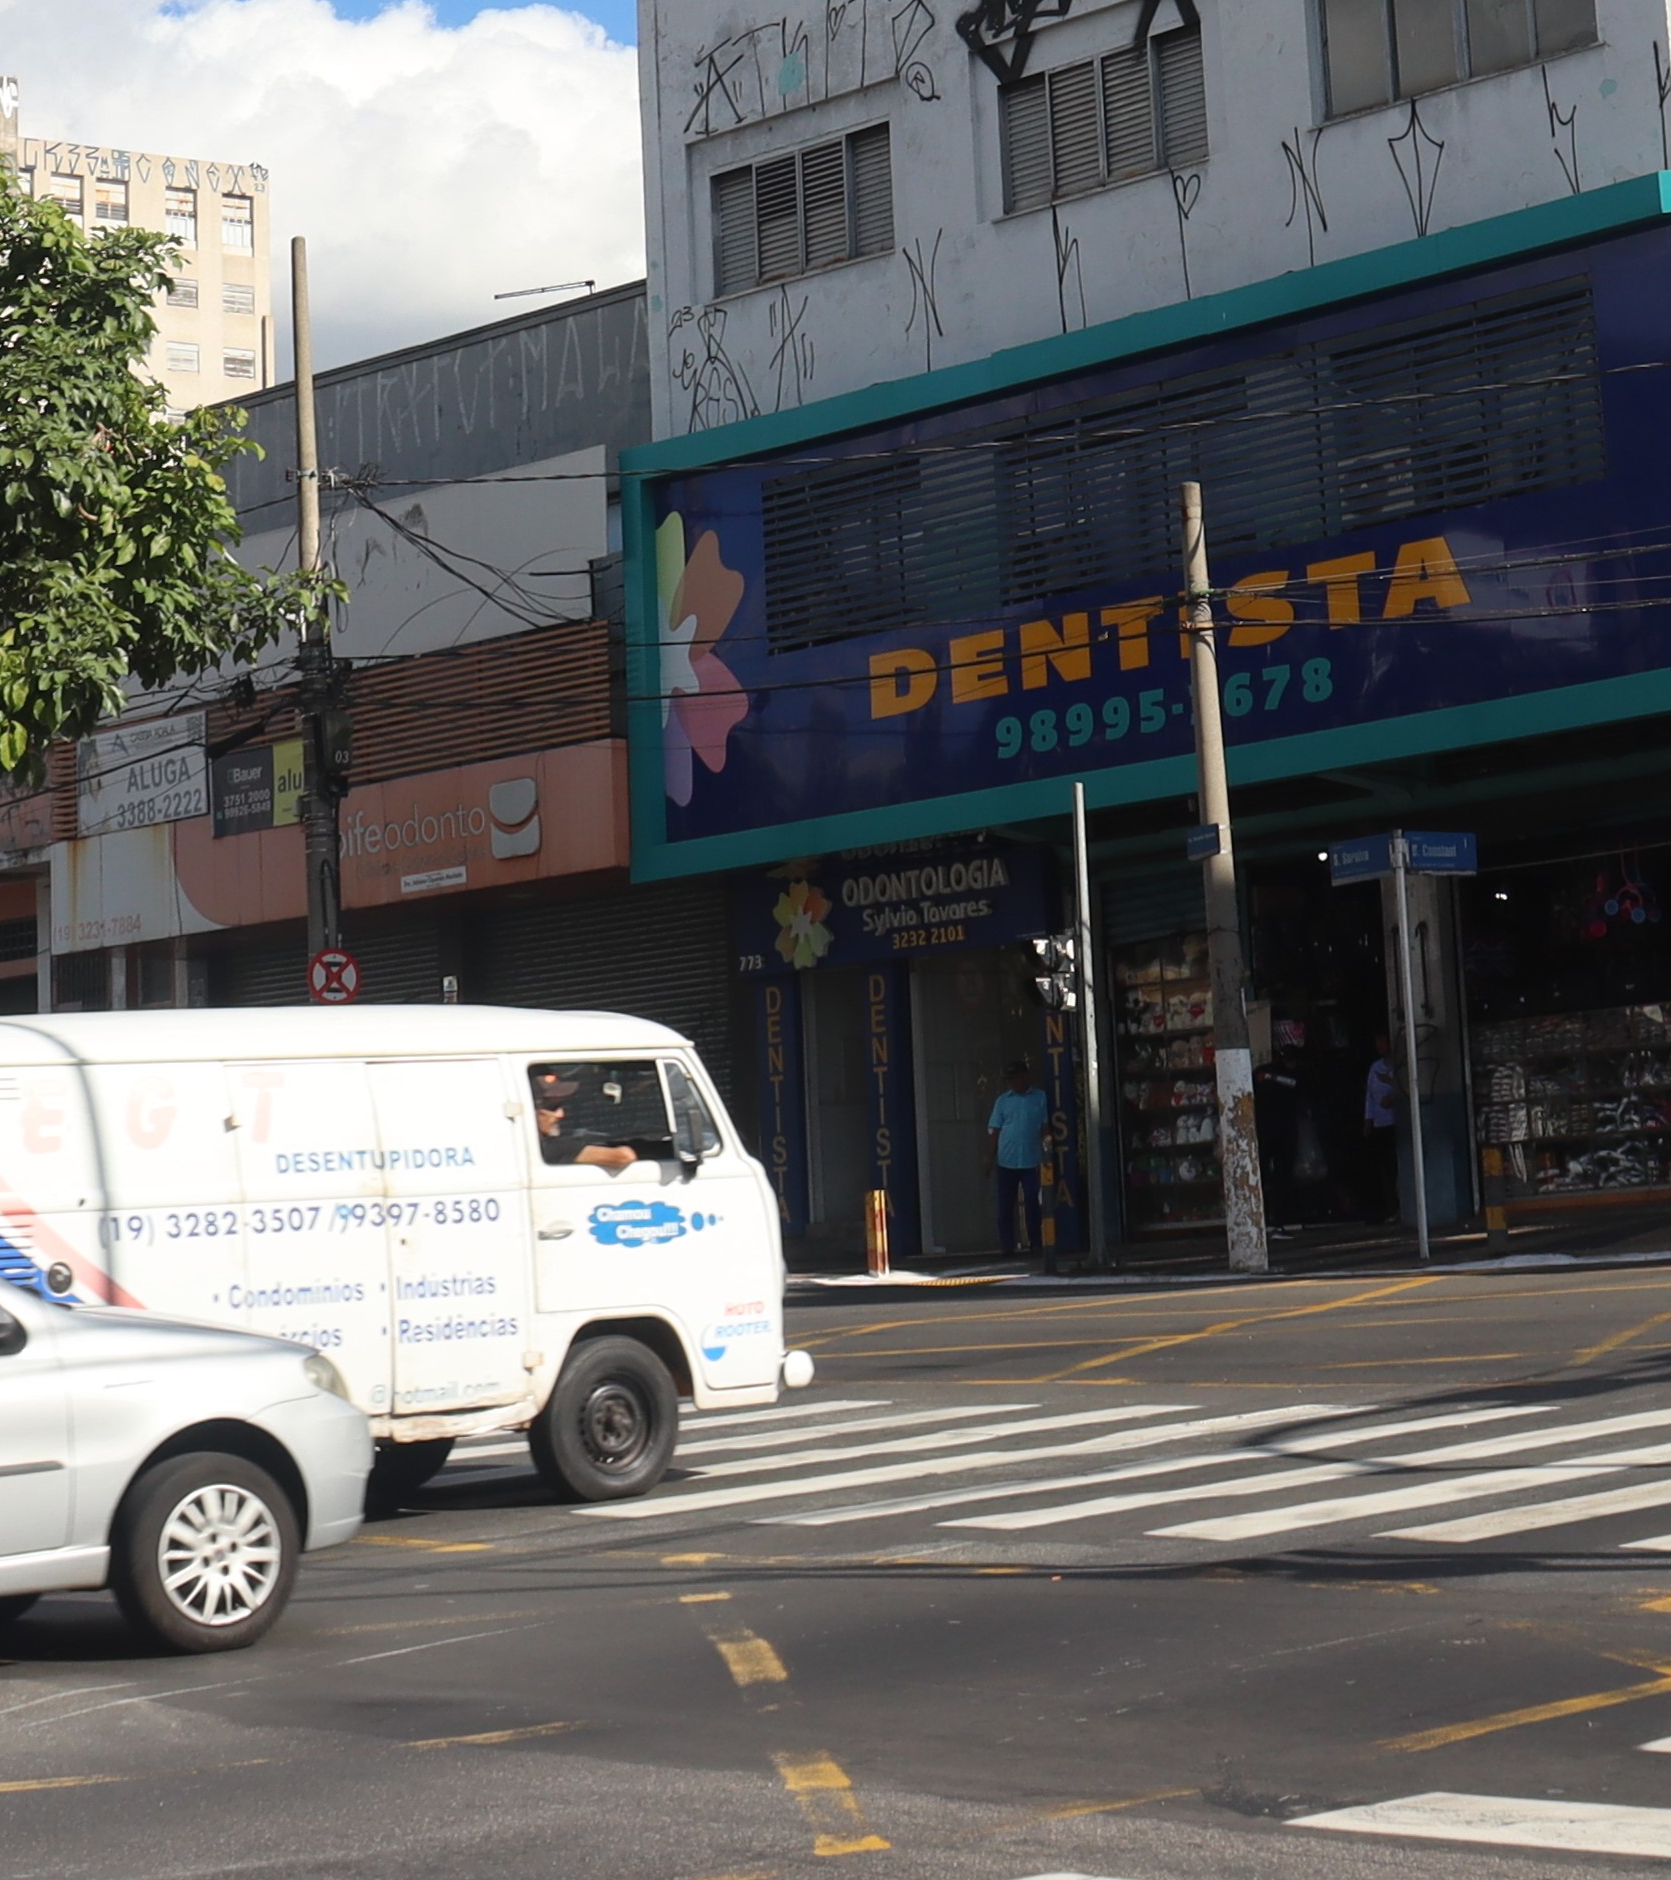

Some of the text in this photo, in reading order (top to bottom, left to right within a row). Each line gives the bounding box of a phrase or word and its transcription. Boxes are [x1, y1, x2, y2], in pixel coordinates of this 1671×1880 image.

[995, 657, 1334, 760] 98995-678
[127, 756, 191, 794] ALUGA
[117, 788, 203, 829] 3388-2222
[842, 857, 1008, 908] ODONTOLOGIA
[891, 924, 966, 950] 3232 2101
[738, 955, 764, 972] 773
[1046, 1015, 1074, 1208] NTISTA
[276, 1146, 476, 1175] DESENTUPIDORA
[166, 1205, 321, 1240] 3282-3507
[229, 1273, 497, 1310] Condomínios Indústrias
[398, 1312, 519, 1345] Residências
